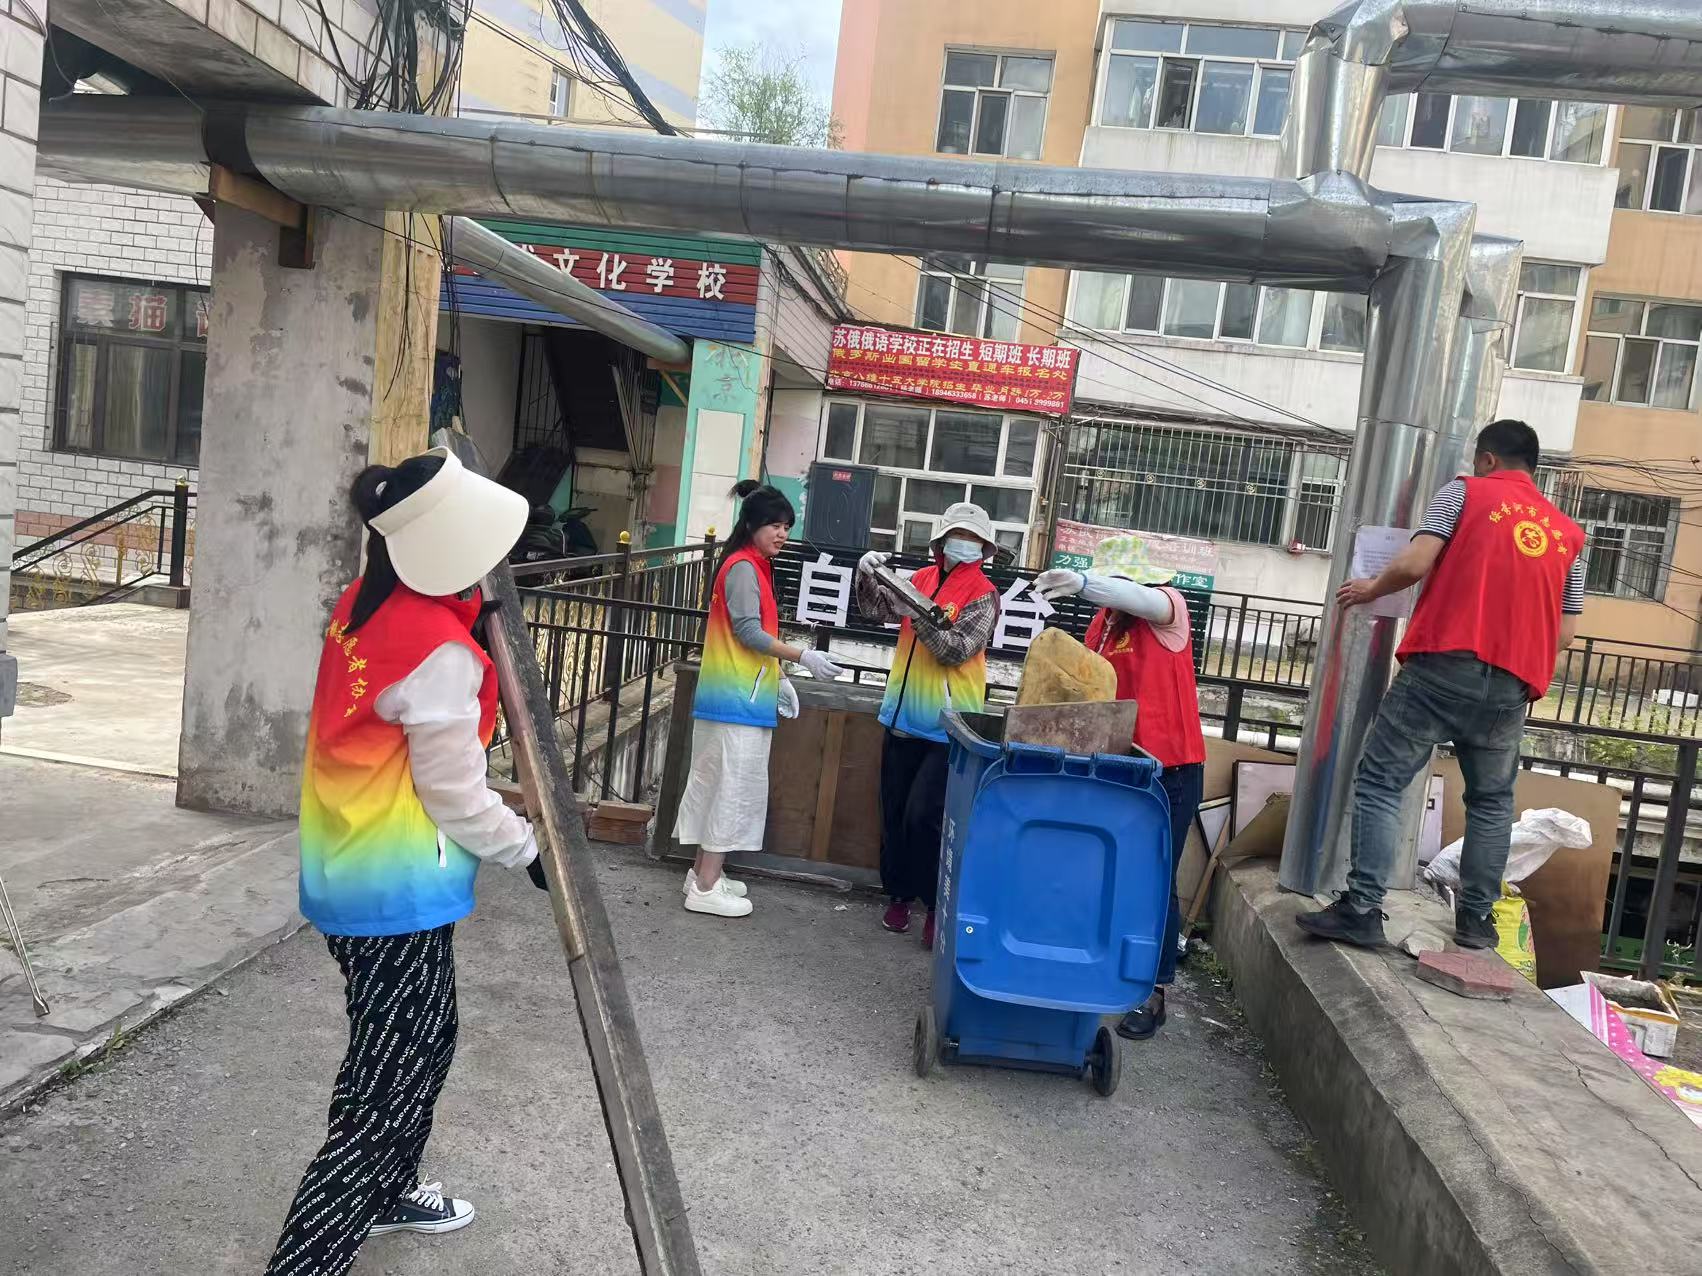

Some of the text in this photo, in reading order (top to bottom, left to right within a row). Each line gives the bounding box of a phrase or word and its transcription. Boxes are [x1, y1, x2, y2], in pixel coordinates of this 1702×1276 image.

[522, 244, 727, 300] 文化学校
[833, 328, 1071, 369] 苏俄俄语学校正在招生 短期班 长期班
[357, 1031, 402, 1103] alexanderwang
